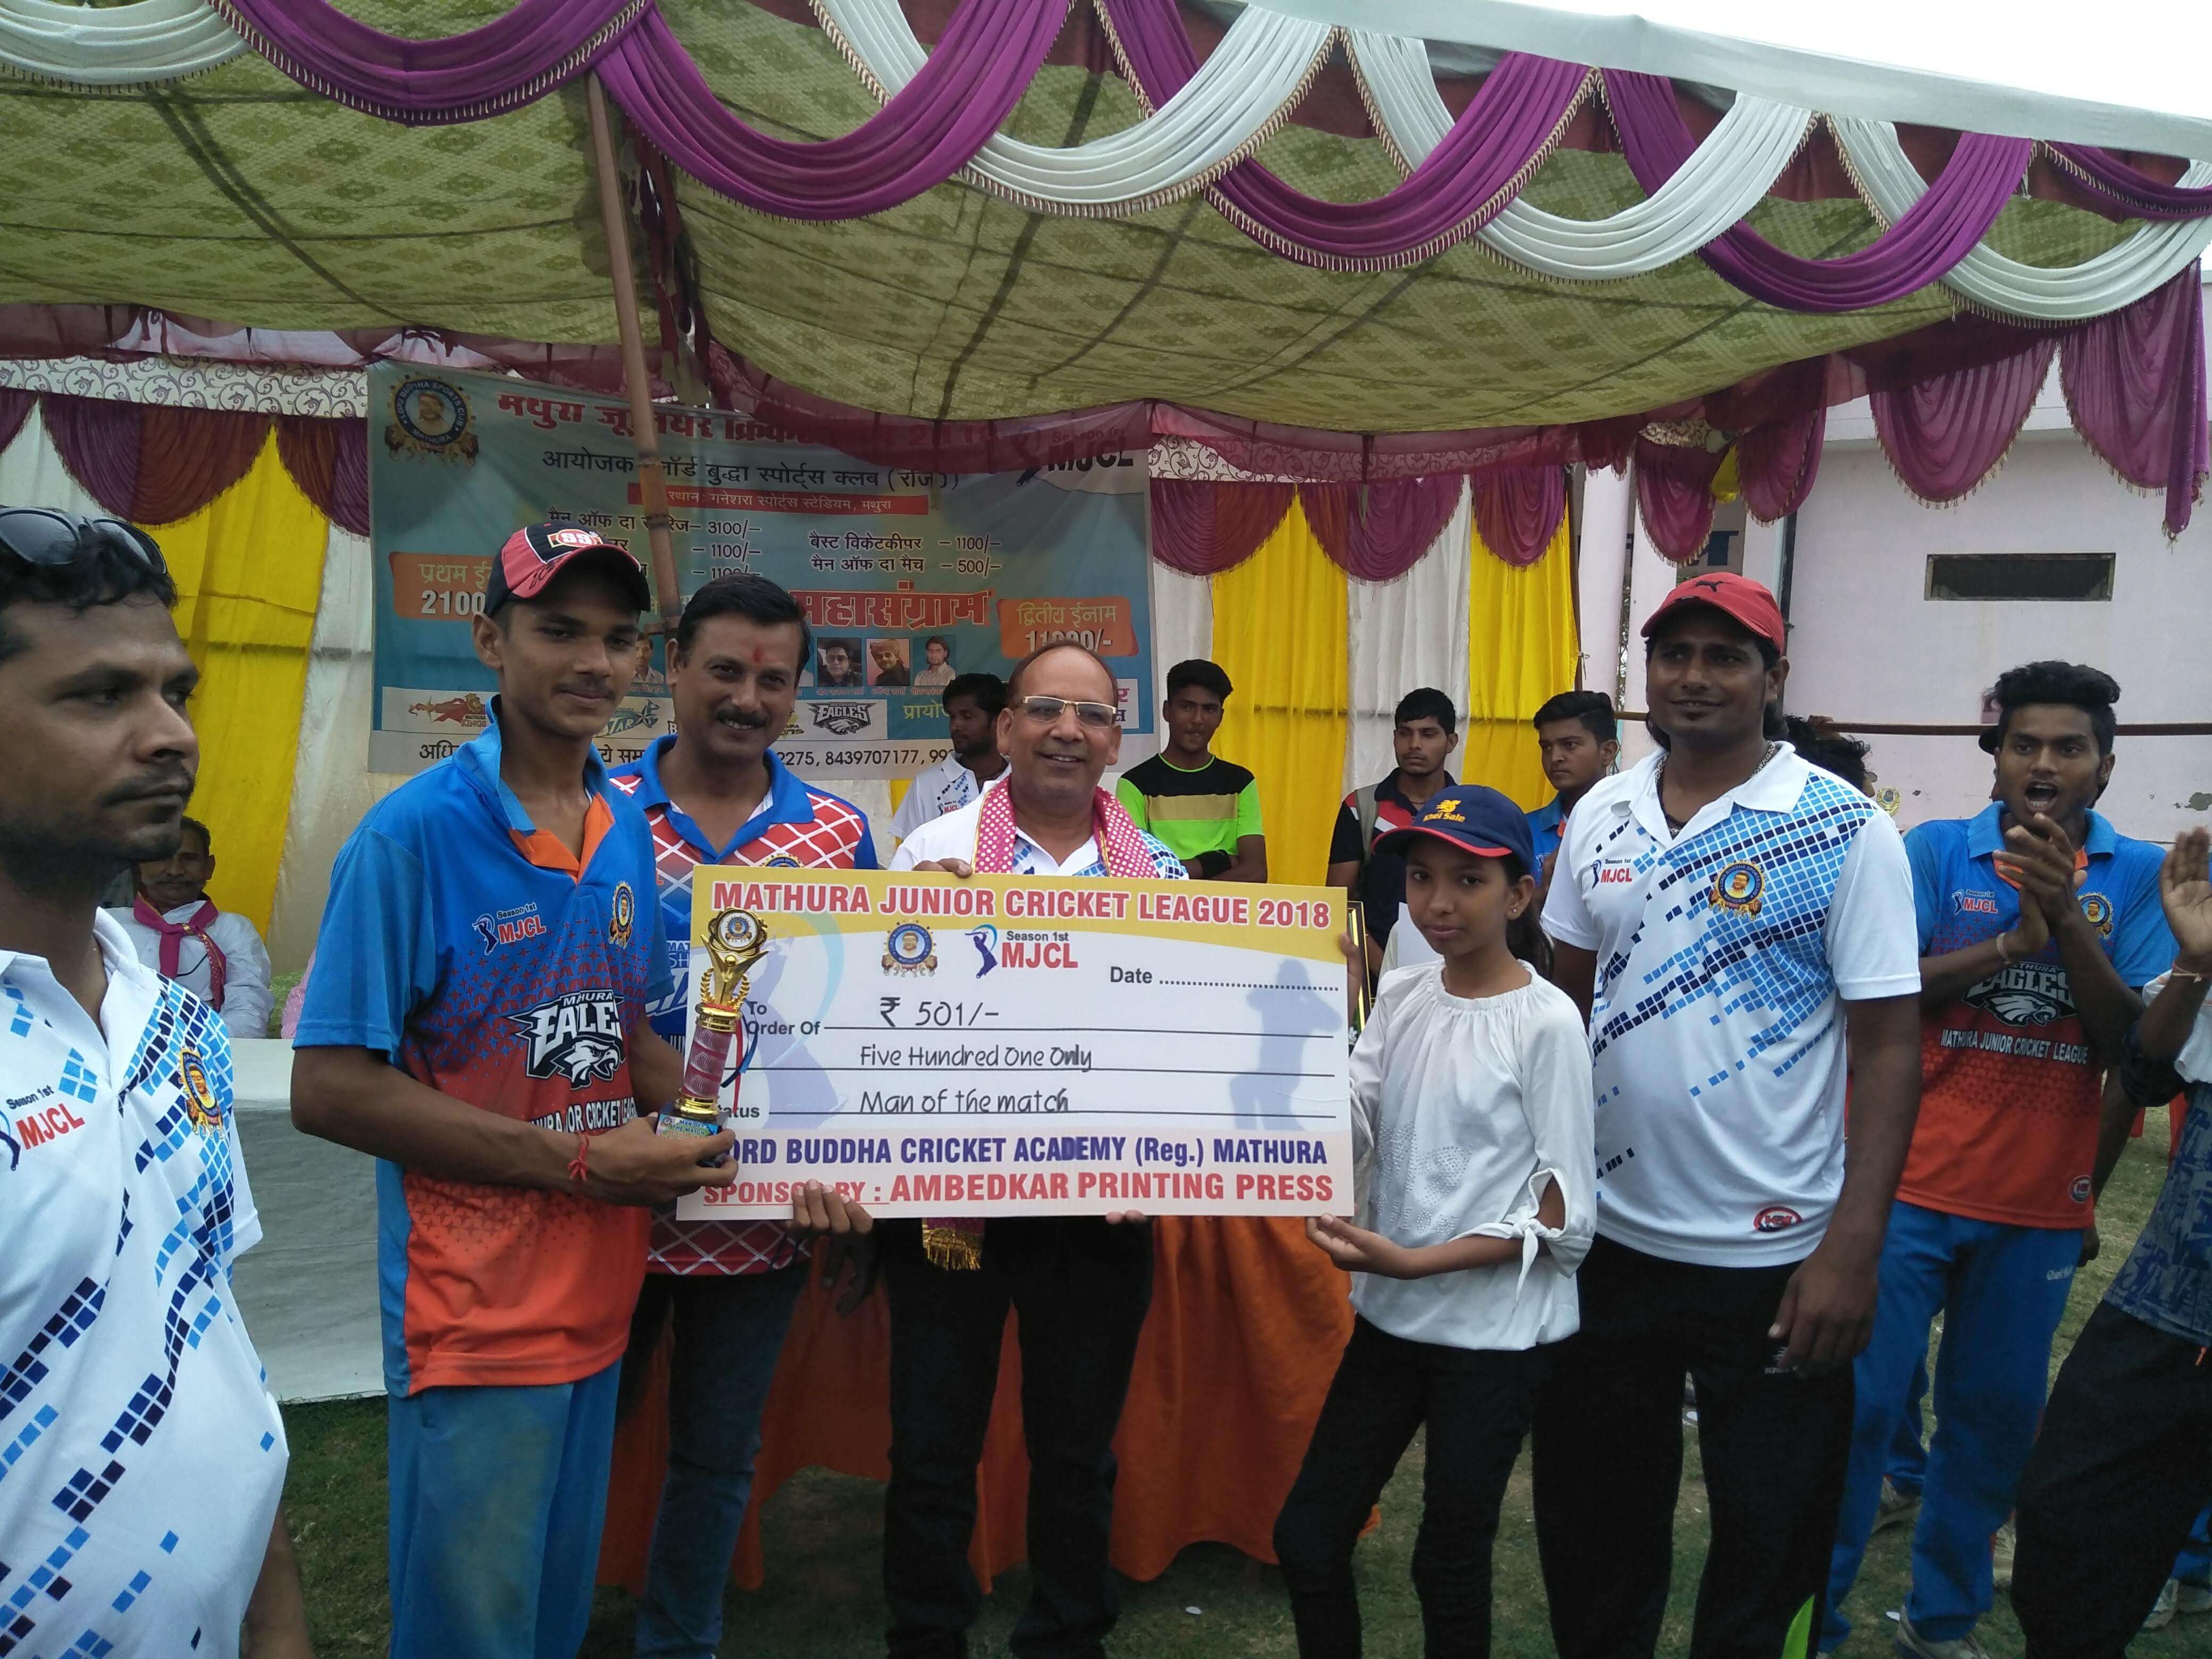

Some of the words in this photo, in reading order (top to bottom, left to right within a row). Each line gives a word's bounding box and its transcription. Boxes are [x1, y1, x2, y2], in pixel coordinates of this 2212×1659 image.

[498, 393, 585, 429] मथुरा
[542, 447, 633, 473] आयोजक
[705, 463, 749, 485] बुद्धा
[833, 470, 878, 486] क्लब
[709, 489, 752, 506] गनेशरा
[862, 500, 892, 513] मथुरा
[548, 506, 572, 522] मैन
[578, 510, 613, 529] ऑफ
[617, 515, 635, 531] दा
[707, 519, 761, 539] 3100/-
[711, 543, 761, 563] 1100/-
[809, 531, 840, 551] बैस्ट
[844, 532, 923, 551] विकेटकीपर
[957, 534, 1001, 554] 1100/-
[418, 563, 467, 584] प्रथम
[811, 555, 834, 572] मैन
[841, 555, 873, 572] ऑफ
[878, 560, 895, 572] दा
[901, 555, 924, 573] मैच
[958, 557, 1002, 577] 500/-
[1016, 601, 1065, 626] द्वितीय
[1069, 602, 1117, 628] ईनाम
[815, 705, 868, 723] EAGLES
[825, 750, 925, 767] 8439707177,
[1442, 812, 1466, 823] Sale
[1601, 867, 1633, 883] MJCL
[497, 907, 524, 919] Season
[525, 902, 537, 912] 1st
[714, 882, 869, 914] MATHURA
[881, 887, 994, 916] JUNIOR
[1006, 890, 1129, 918] CRICKET
[1139, 894, 1248, 924] LEAGUE
[1258, 901, 1330, 928] 2018
[1964, 898, 1998, 913] MJCL
[498, 916, 547, 943] MJCL
[1007, 931, 1049, 941] Season
[1052, 931, 1069, 941] 1st
[1002, 943, 1078, 968] MJCL
[1110, 967, 1153, 984] Date
[745, 1021, 795, 1036] Order
[800, 1020, 821, 1036] Of
[915, 1002, 999, 1027] 501/-
[748, 1002, 767, 1016] To
[860, 1045, 902, 1066] Five
[908, 1043, 999, 1066] Hundred
[1005, 1046, 1044, 1066] One
[1050, 1044, 1092, 1073] Only
[1940, 1029, 1978, 1049] MATHURA
[1980, 1032, 2012, 1054] JUNIOR
[2014, 1037, 2051, 1059] CRICKET
[2052, 1043, 2089, 1063] LEAGUE
[719, 1106, 760, 1118] tatus
[860, 1091, 914, 1114] Man
[922, 1088, 946, 1113] of
[955, 1089, 992, 1112] the
[998, 1088, 1068, 1113] match
[16, 1103, 86, 1150] MJCL
[786, 1139, 892, 1163] BUDDHA
[901, 1138, 1006, 1163] CRICKET
[1013, 1136, 1126, 1161] ACADEMY
[1135, 1138, 1204, 1167] (Reg.)
[1214, 1139, 1327, 1164] MATHURA
[836, 1182, 866, 1202] BY
[890, 1173, 1069, 1202] AMBEDKAR
[1077, 1173, 1224, 1200] PRINTING
[1236, 1174, 1333, 1201] PRESS
